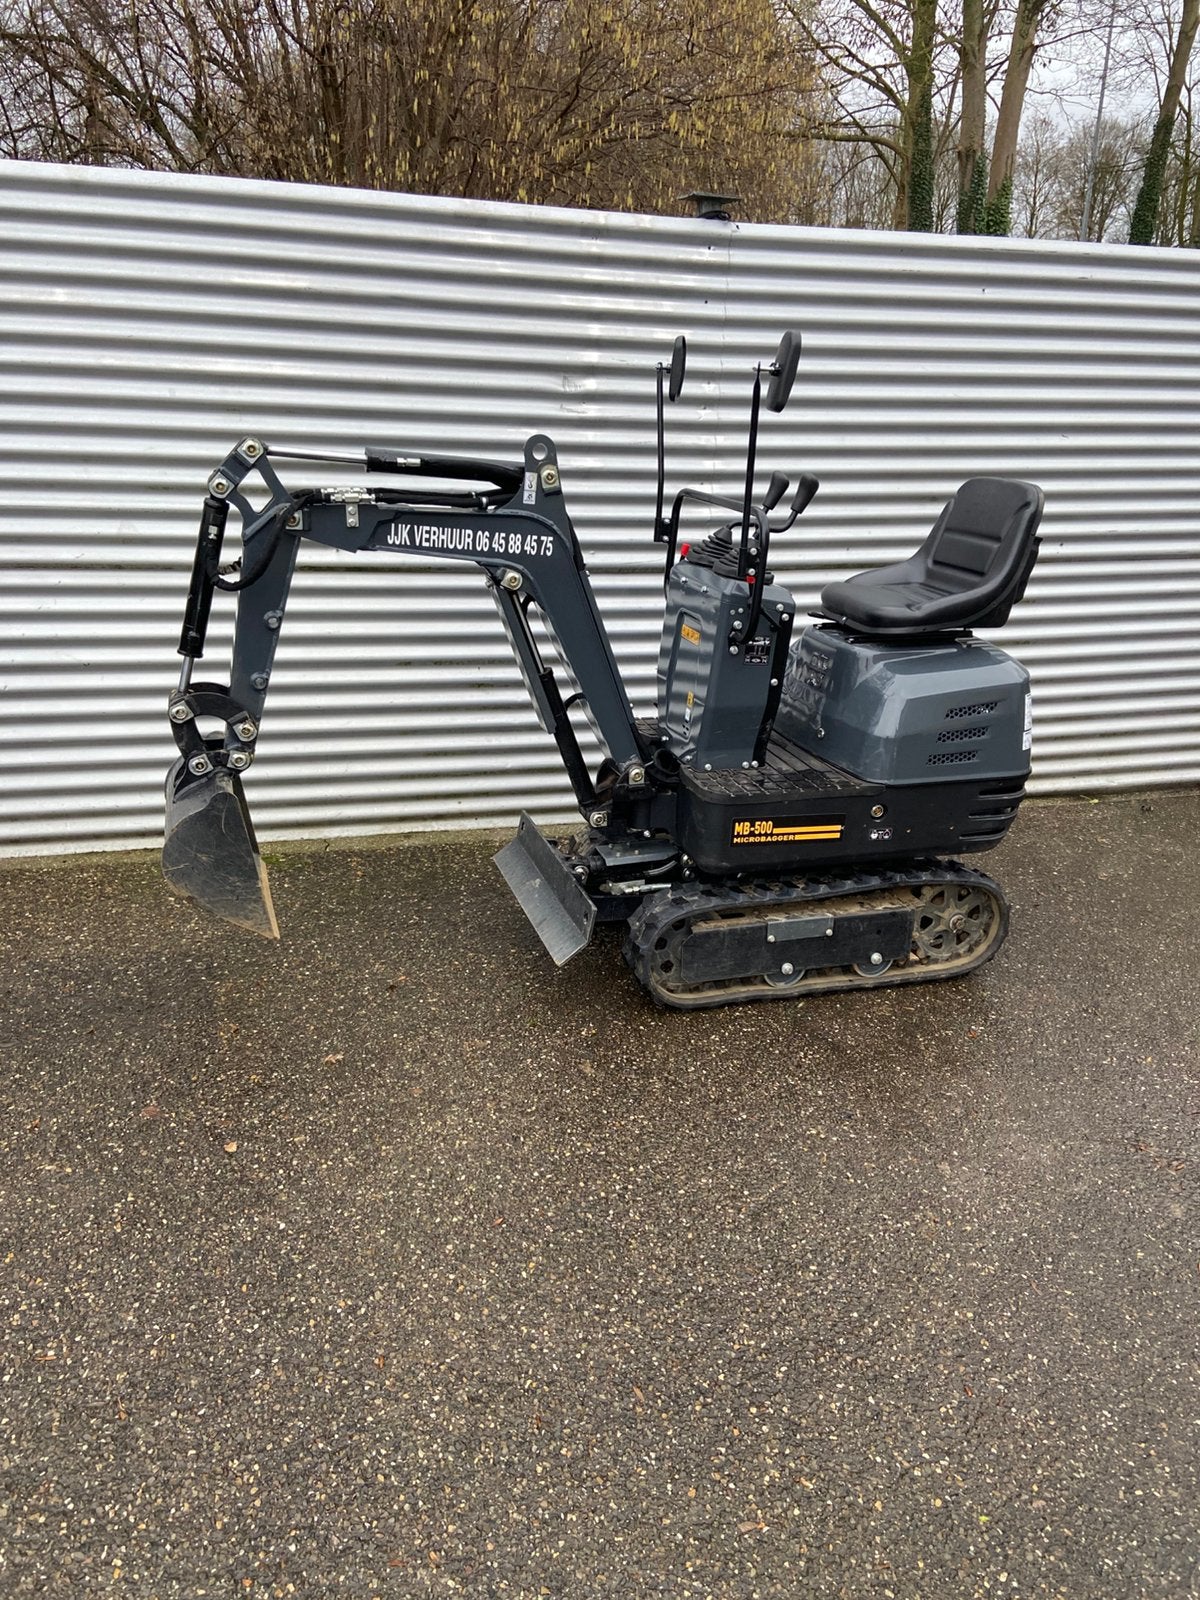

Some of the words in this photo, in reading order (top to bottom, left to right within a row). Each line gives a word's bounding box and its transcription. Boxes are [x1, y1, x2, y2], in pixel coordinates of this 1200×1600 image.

[387, 523, 411, 546] JJK
[413, 525, 473, 550] VERHUUR
[475, 530, 490, 552] 06
[492, 532, 506, 553] 45
[508, 533, 522, 554] 88
[524, 534, 538, 556] 45
[540, 535, 554, 557] 75
[734, 820, 774, 836] MB-500
[733, 834, 795, 844] MICROBAGGER
